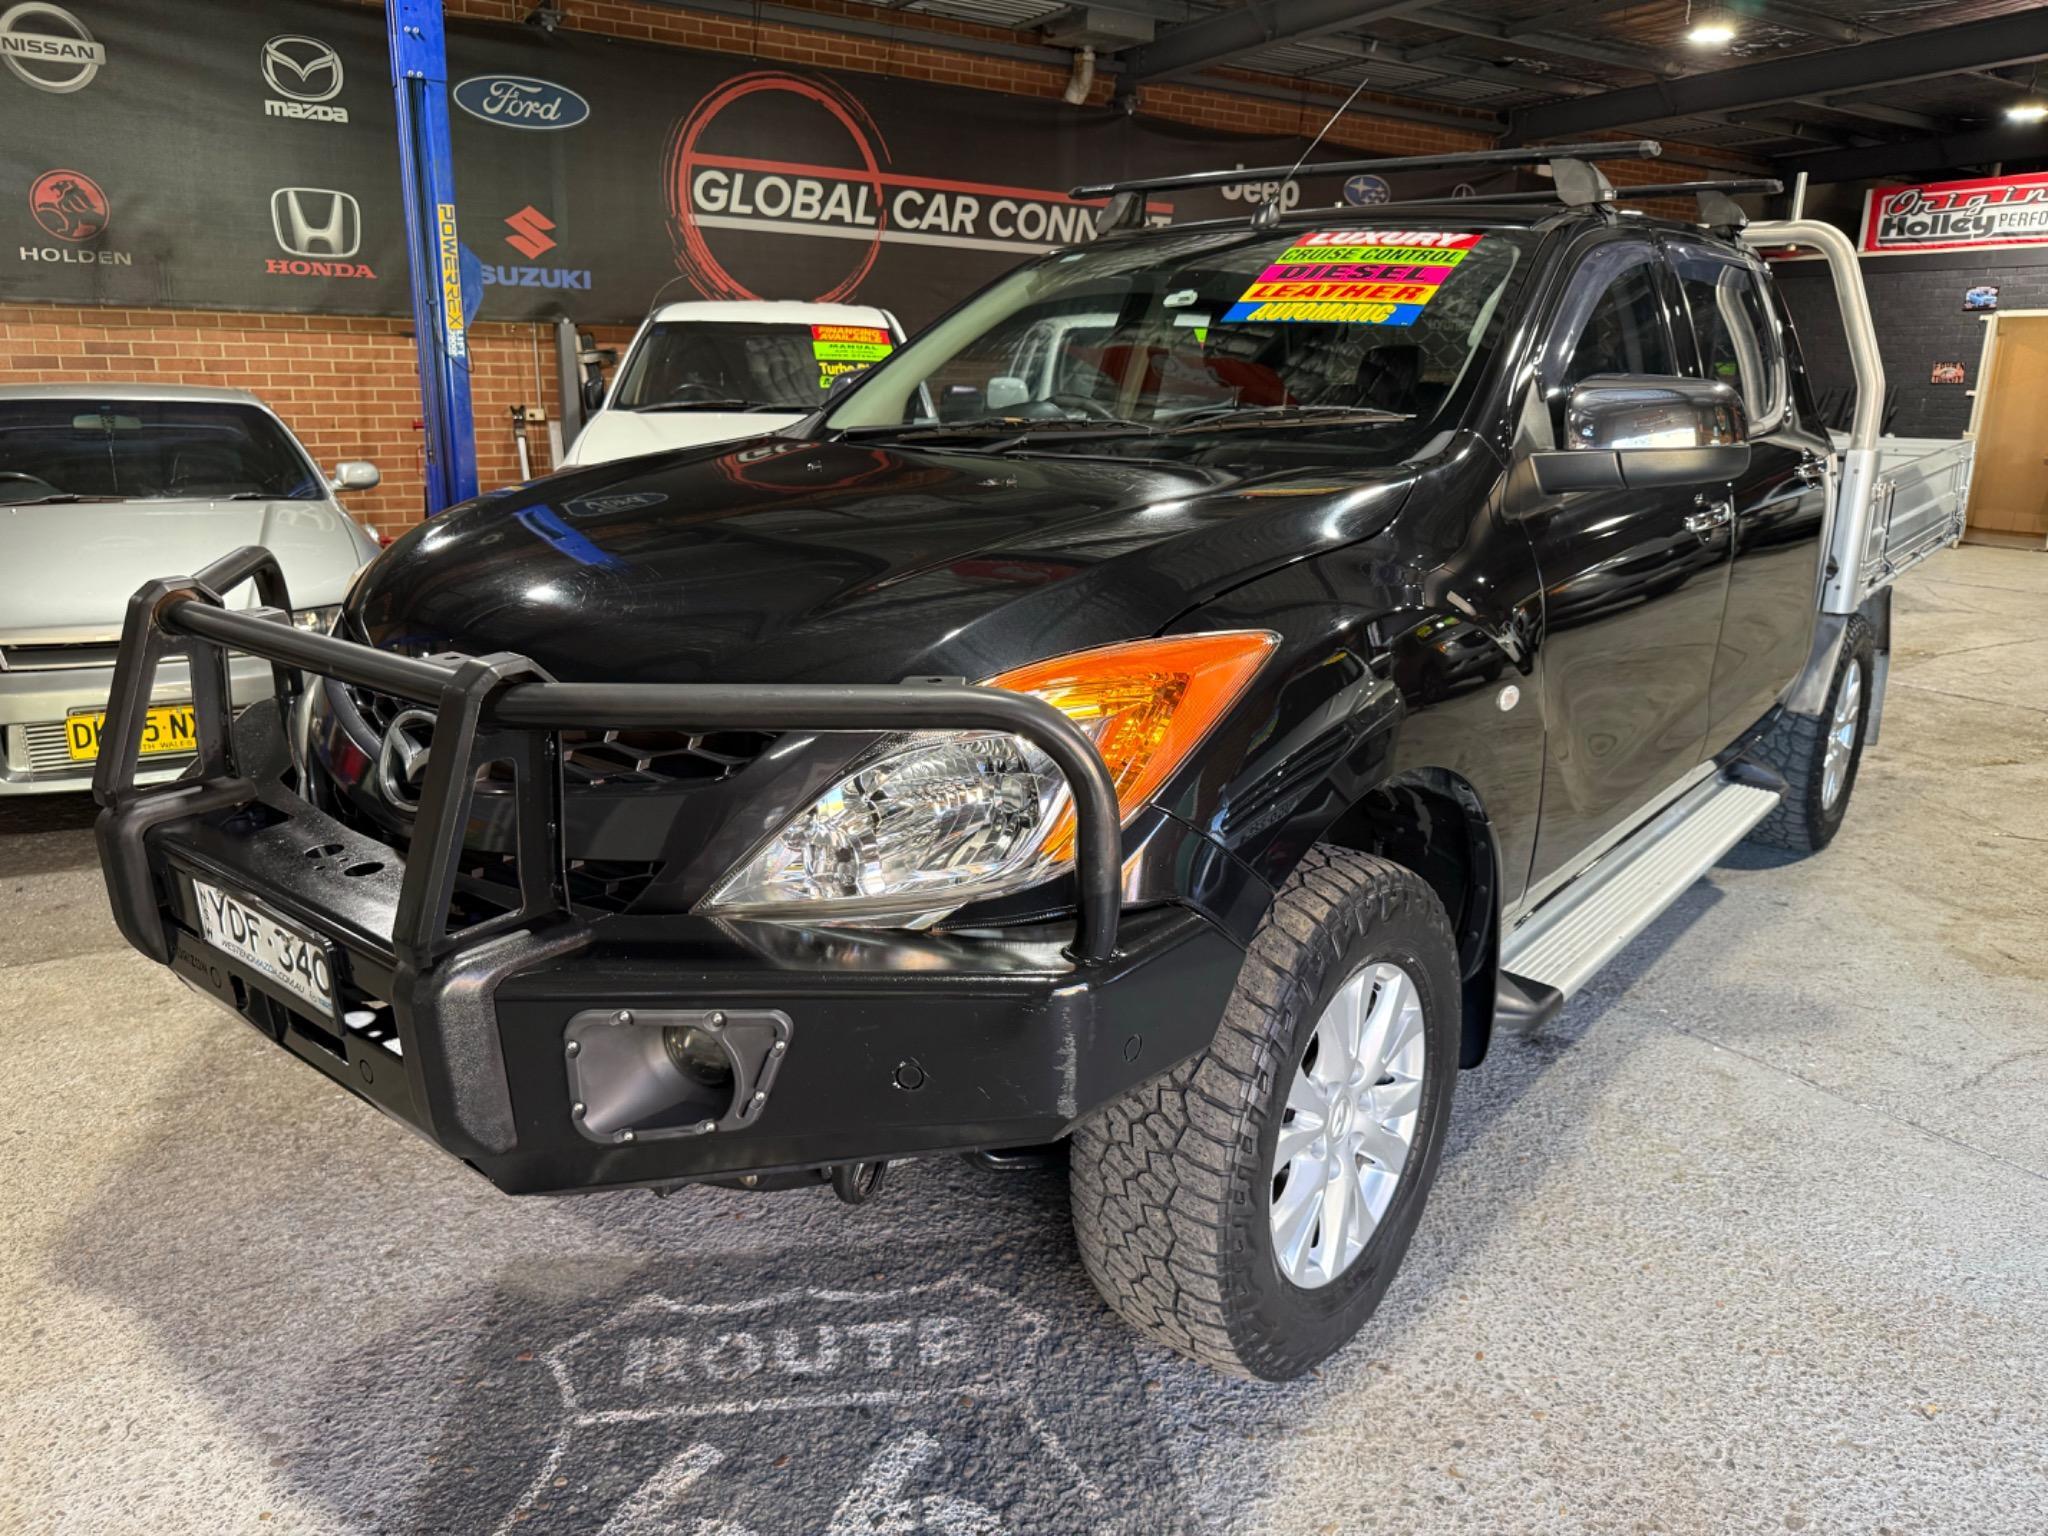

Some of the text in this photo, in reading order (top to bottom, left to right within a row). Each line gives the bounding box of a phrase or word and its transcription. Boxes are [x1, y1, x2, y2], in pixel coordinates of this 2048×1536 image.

[1, 37, 95, 60] NISSAN
[482, 80, 562, 120] Ford
[692, 169, 877, 225] GLOBAL
[892, 190, 979, 235] CAR
[1879, 211, 2048, 239] Holley PERFO
[1306, 231, 1474, 247] LUXURY
[19, 246, 132, 266] HOLDEN
[1280, 247, 1459, 264] CRUISE CONTROL
[264, 258, 378, 280] HONDA
[481, 264, 592, 291] SUZUKI
[1276, 264, 1427, 281] DIESEL
[1250, 284, 1426, 300] LEATHER
[1246, 302, 1399, 323] AUTOMATIC
